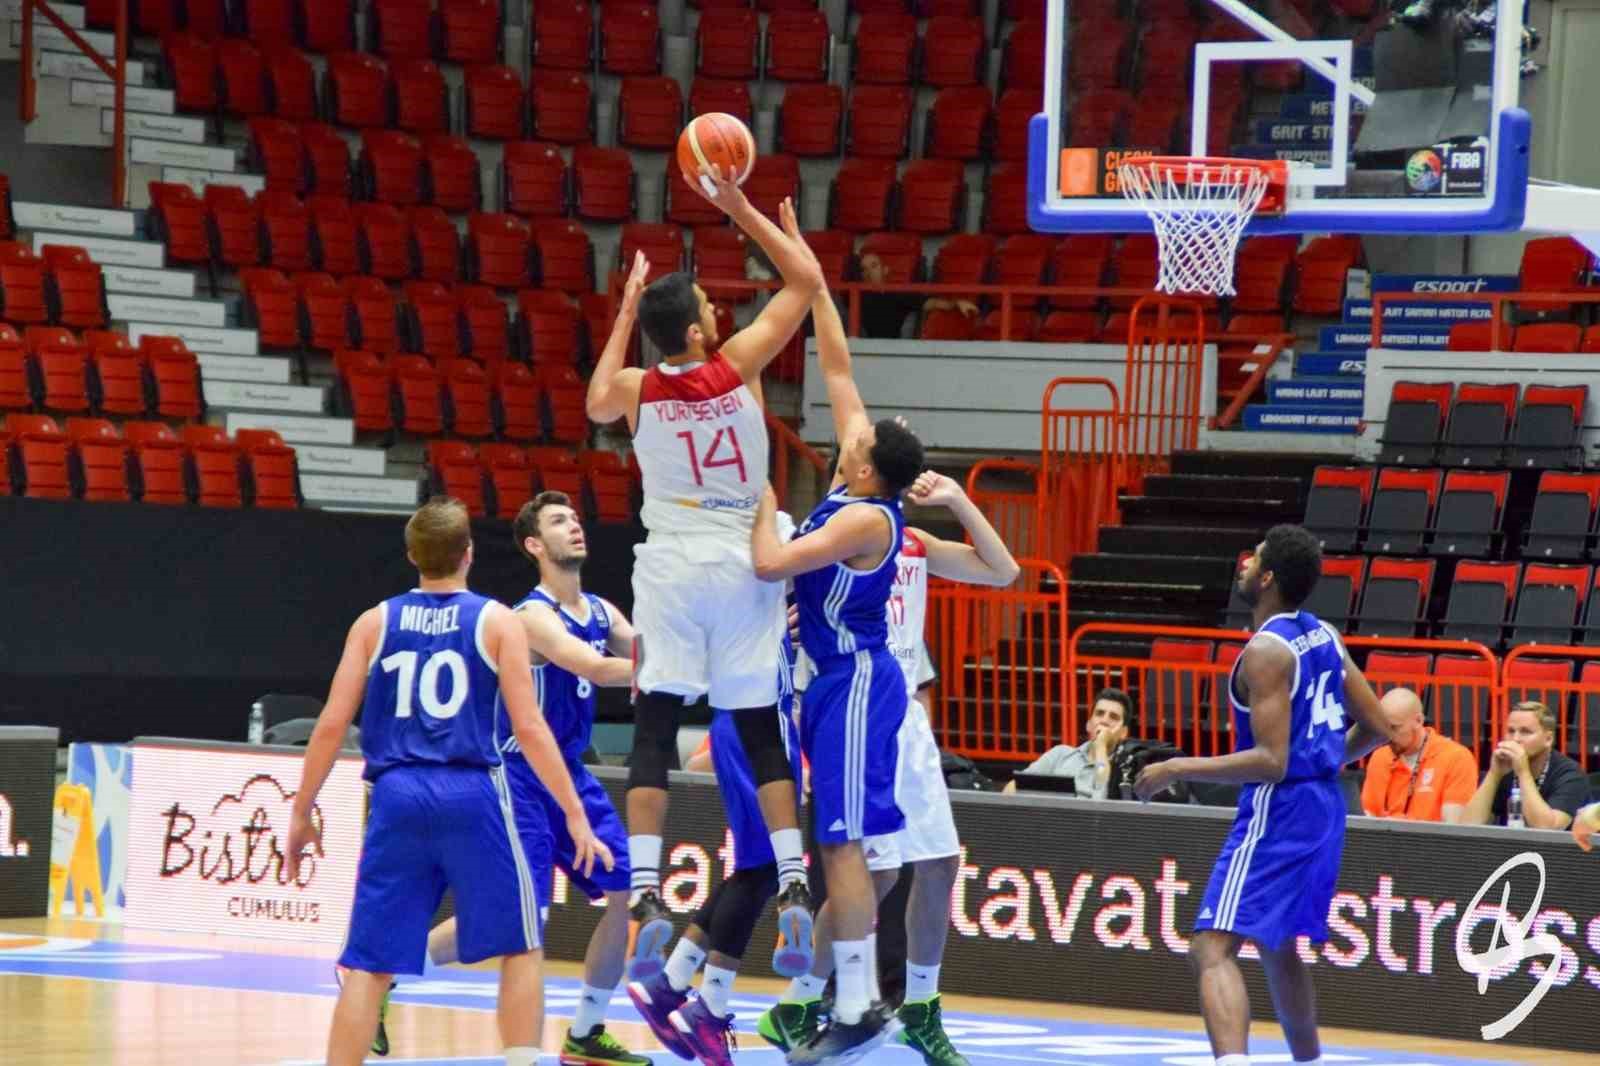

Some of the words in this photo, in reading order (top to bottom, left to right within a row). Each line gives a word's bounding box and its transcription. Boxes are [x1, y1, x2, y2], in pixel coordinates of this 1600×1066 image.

[1452, 152, 1480, 169] FIBA
[1412, 278, 1487, 293] esport
[655, 391, 744, 422] YURTSEVEN
[676, 425, 747, 487] 14
[400, 604, 461, 635] MICHEL
[381, 649, 469, 719] 10
[159, 801, 317, 890] Bistro
[227, 896, 320, 923] CUMULUS
